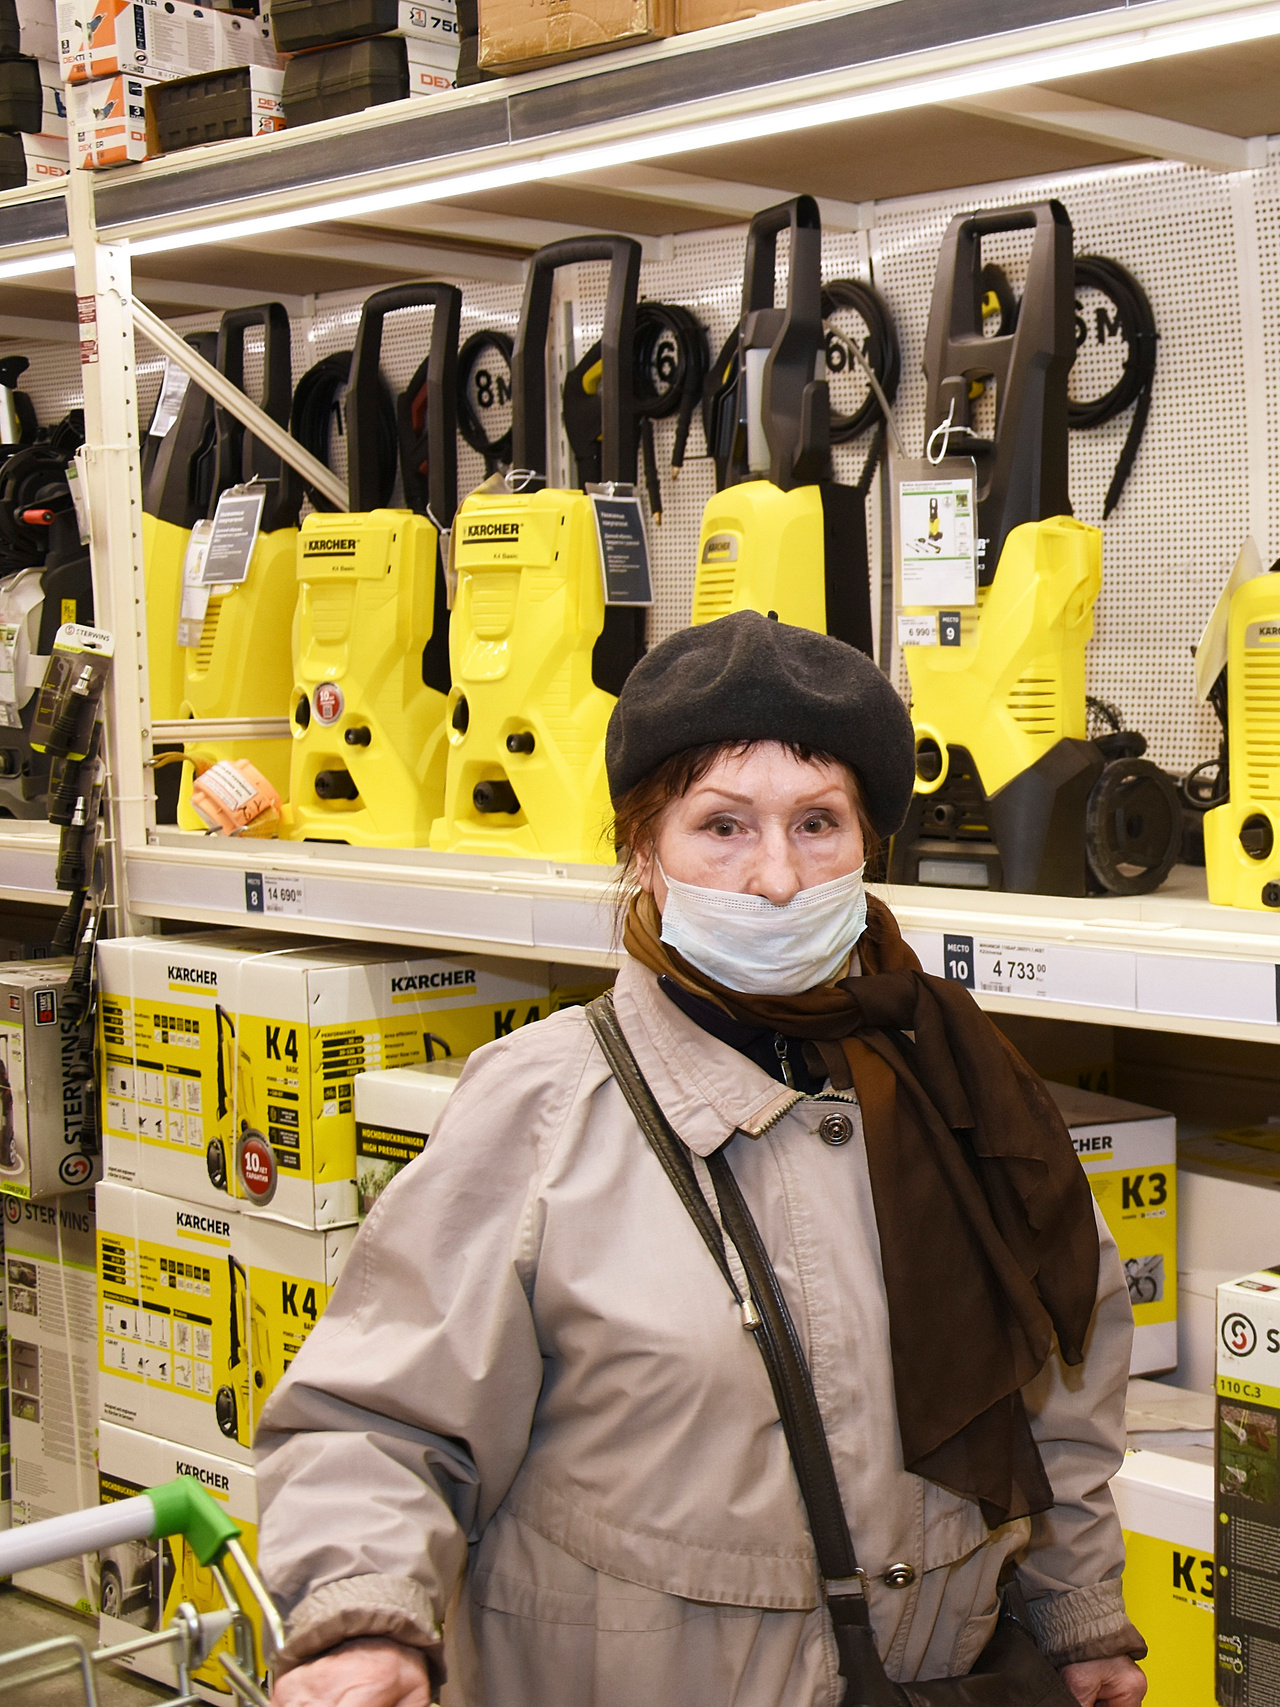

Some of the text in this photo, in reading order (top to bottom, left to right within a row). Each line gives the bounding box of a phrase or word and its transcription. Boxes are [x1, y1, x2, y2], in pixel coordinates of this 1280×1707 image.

[79, 140, 104, 152] DEXER
[468, 524, 519, 537] KÄRCHER
[308, 539, 356, 551] KÄRCHER
[946, 627, 955, 640] 9
[251, 891, 258, 906] 8
[268, 887, 296, 902] 14 690
[947, 943, 970, 953] МЕСТО
[168, 965, 218, 986] KÄRCHER
[949, 960, 969, 980] 10
[993, 960, 1047, 980] 4 733 00
[391, 970, 476, 992] KÄRCHER
[266, 1025, 298, 1063] K4
[362, 1128, 425, 1147] HOCHDRUCKREINIGER
[362, 1142, 408, 1159] HIGH PRESSURE
[245, 1152, 260, 1172] 10
[1122, 1172, 1167, 1210] K3
[177, 1211, 231, 1237] KÄRCHER
[282, 1280, 317, 1321] K4
[1220, 1379, 1261, 1399] 110 C.3
[1172, 1551, 1215, 1597] K3
